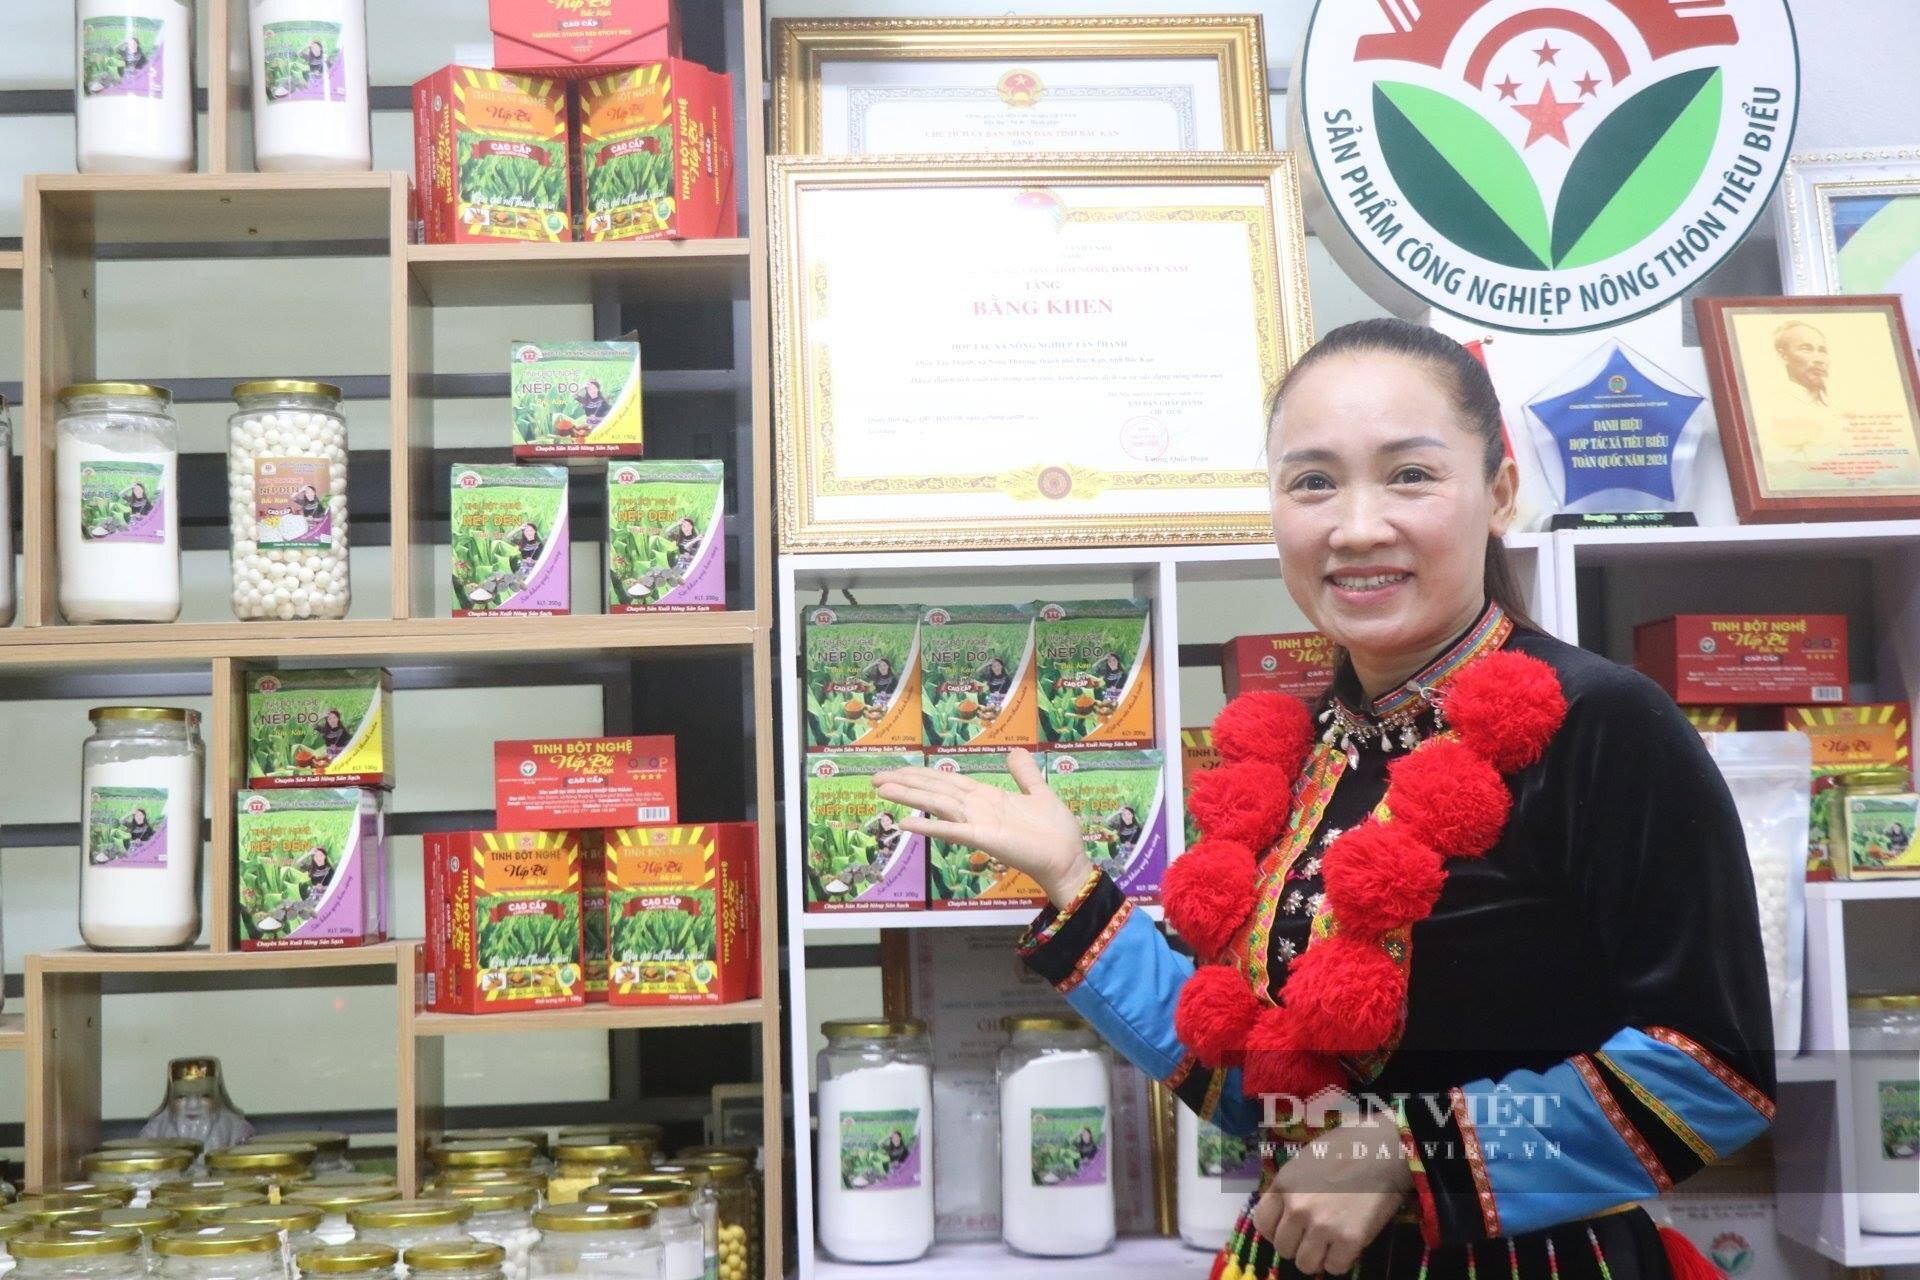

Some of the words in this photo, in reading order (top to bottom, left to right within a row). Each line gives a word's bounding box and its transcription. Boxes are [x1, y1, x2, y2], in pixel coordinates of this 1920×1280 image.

[1740, 86, 1782, 156] BIỂU
[1323, 107, 1362, 165] SẢN
[490, 142, 511, 152] CAO
[513, 142, 533, 154] CẤP
[611, 144, 630, 155] CAO
[630, 138, 646, 152] CẤP
[1711, 157, 1764, 221] TIÊU
[1340, 162, 1401, 247] PHẨM
[1655, 214, 1727, 286] THÔN
[1396, 234, 1462, 296] CÔNG
[1580, 264, 1662, 312] NÔNG
[1047, 299, 1113, 315] KHEN
[1467, 279, 1572, 324] NGHIỆP
[1647, 455, 1667, 465] 2024
[1711, 621, 1740, 633] TINH
[1743, 618, 1768, 634] BỘT
[1771, 618, 1808, 635] NGHỆ
[1272, 638, 1301, 650] TINH
[532, 743, 563, 755] TINH
[566, 741, 592, 757] BỘT
[596, 739, 633, 755] NGHỆ
[1186, 749, 1211, 759] TINH
[567, 777, 586, 785] CAO
[586, 775, 605, 784] CẤP
[490, 850, 512, 862] TINH
[514, 849, 533, 863] BỘT
[534, 849, 561, 860] NGHỆ
[508, 902, 529, 912] CAO
[530, 898, 548, 910] CẤP
[641, 898, 661, 908] CAO
[662, 894, 682, 907] CẤP
